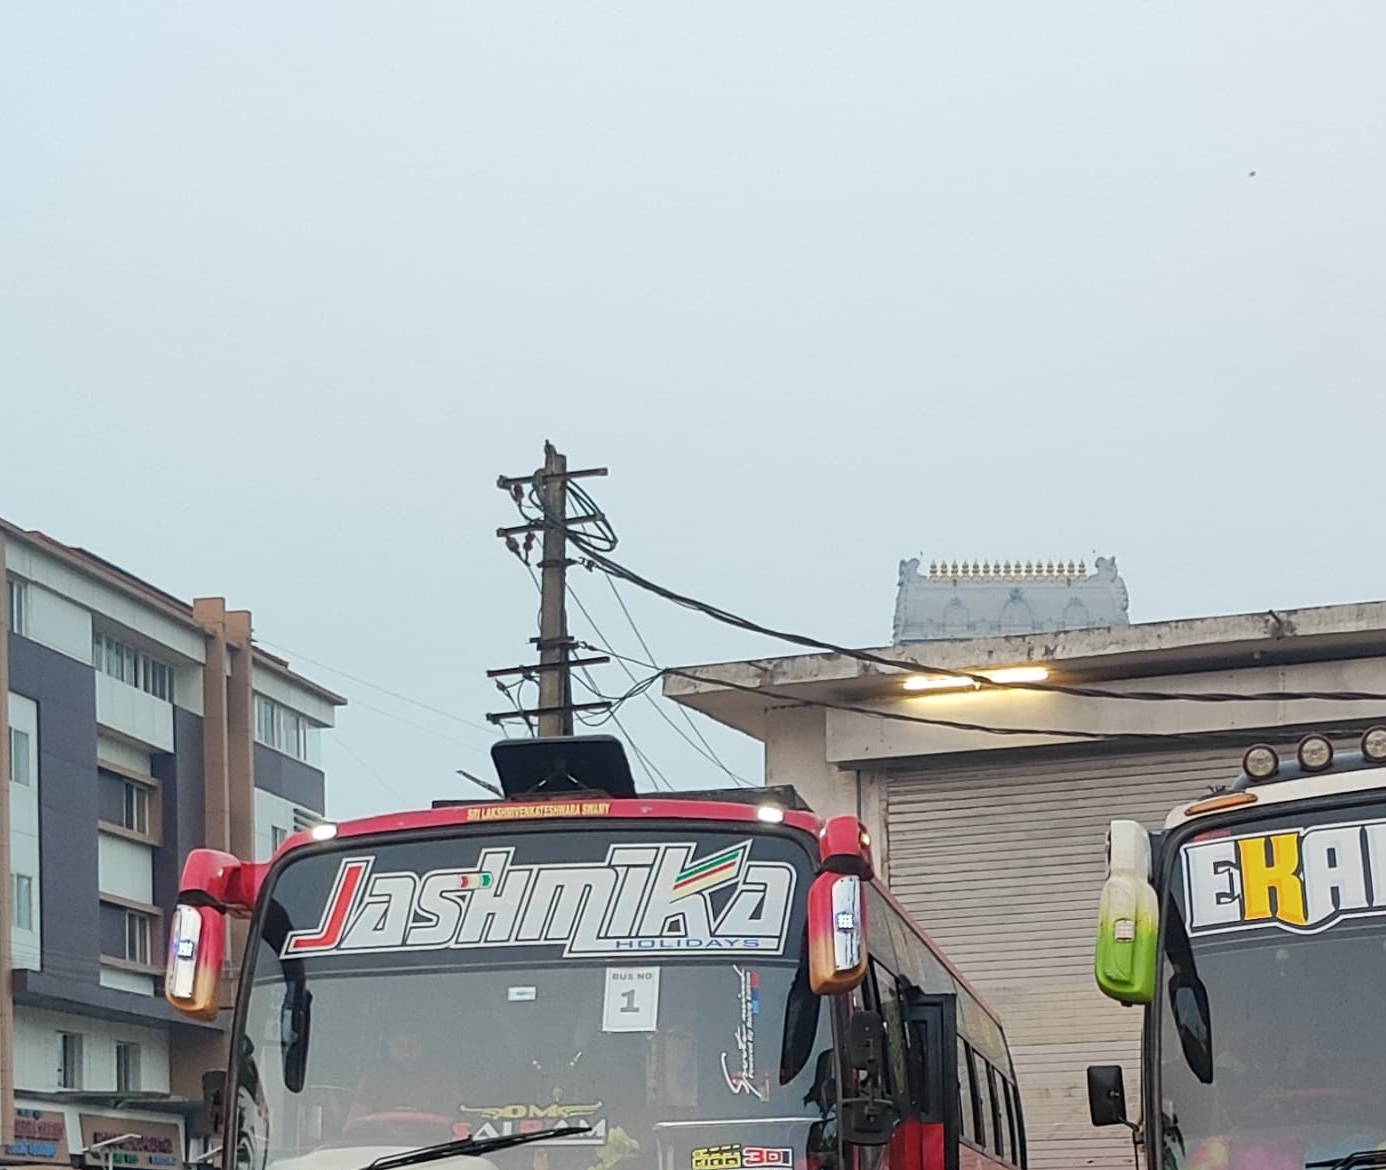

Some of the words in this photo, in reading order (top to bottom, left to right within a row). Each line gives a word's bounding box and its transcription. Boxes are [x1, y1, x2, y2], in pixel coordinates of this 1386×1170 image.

[467, 808, 481, 821] SRI
[615, 938, 761, 950] HOLIDAYS
[613, 972, 634, 981] BUS
[637, 972, 653, 981] NO
[620, 989, 640, 1013] 1
